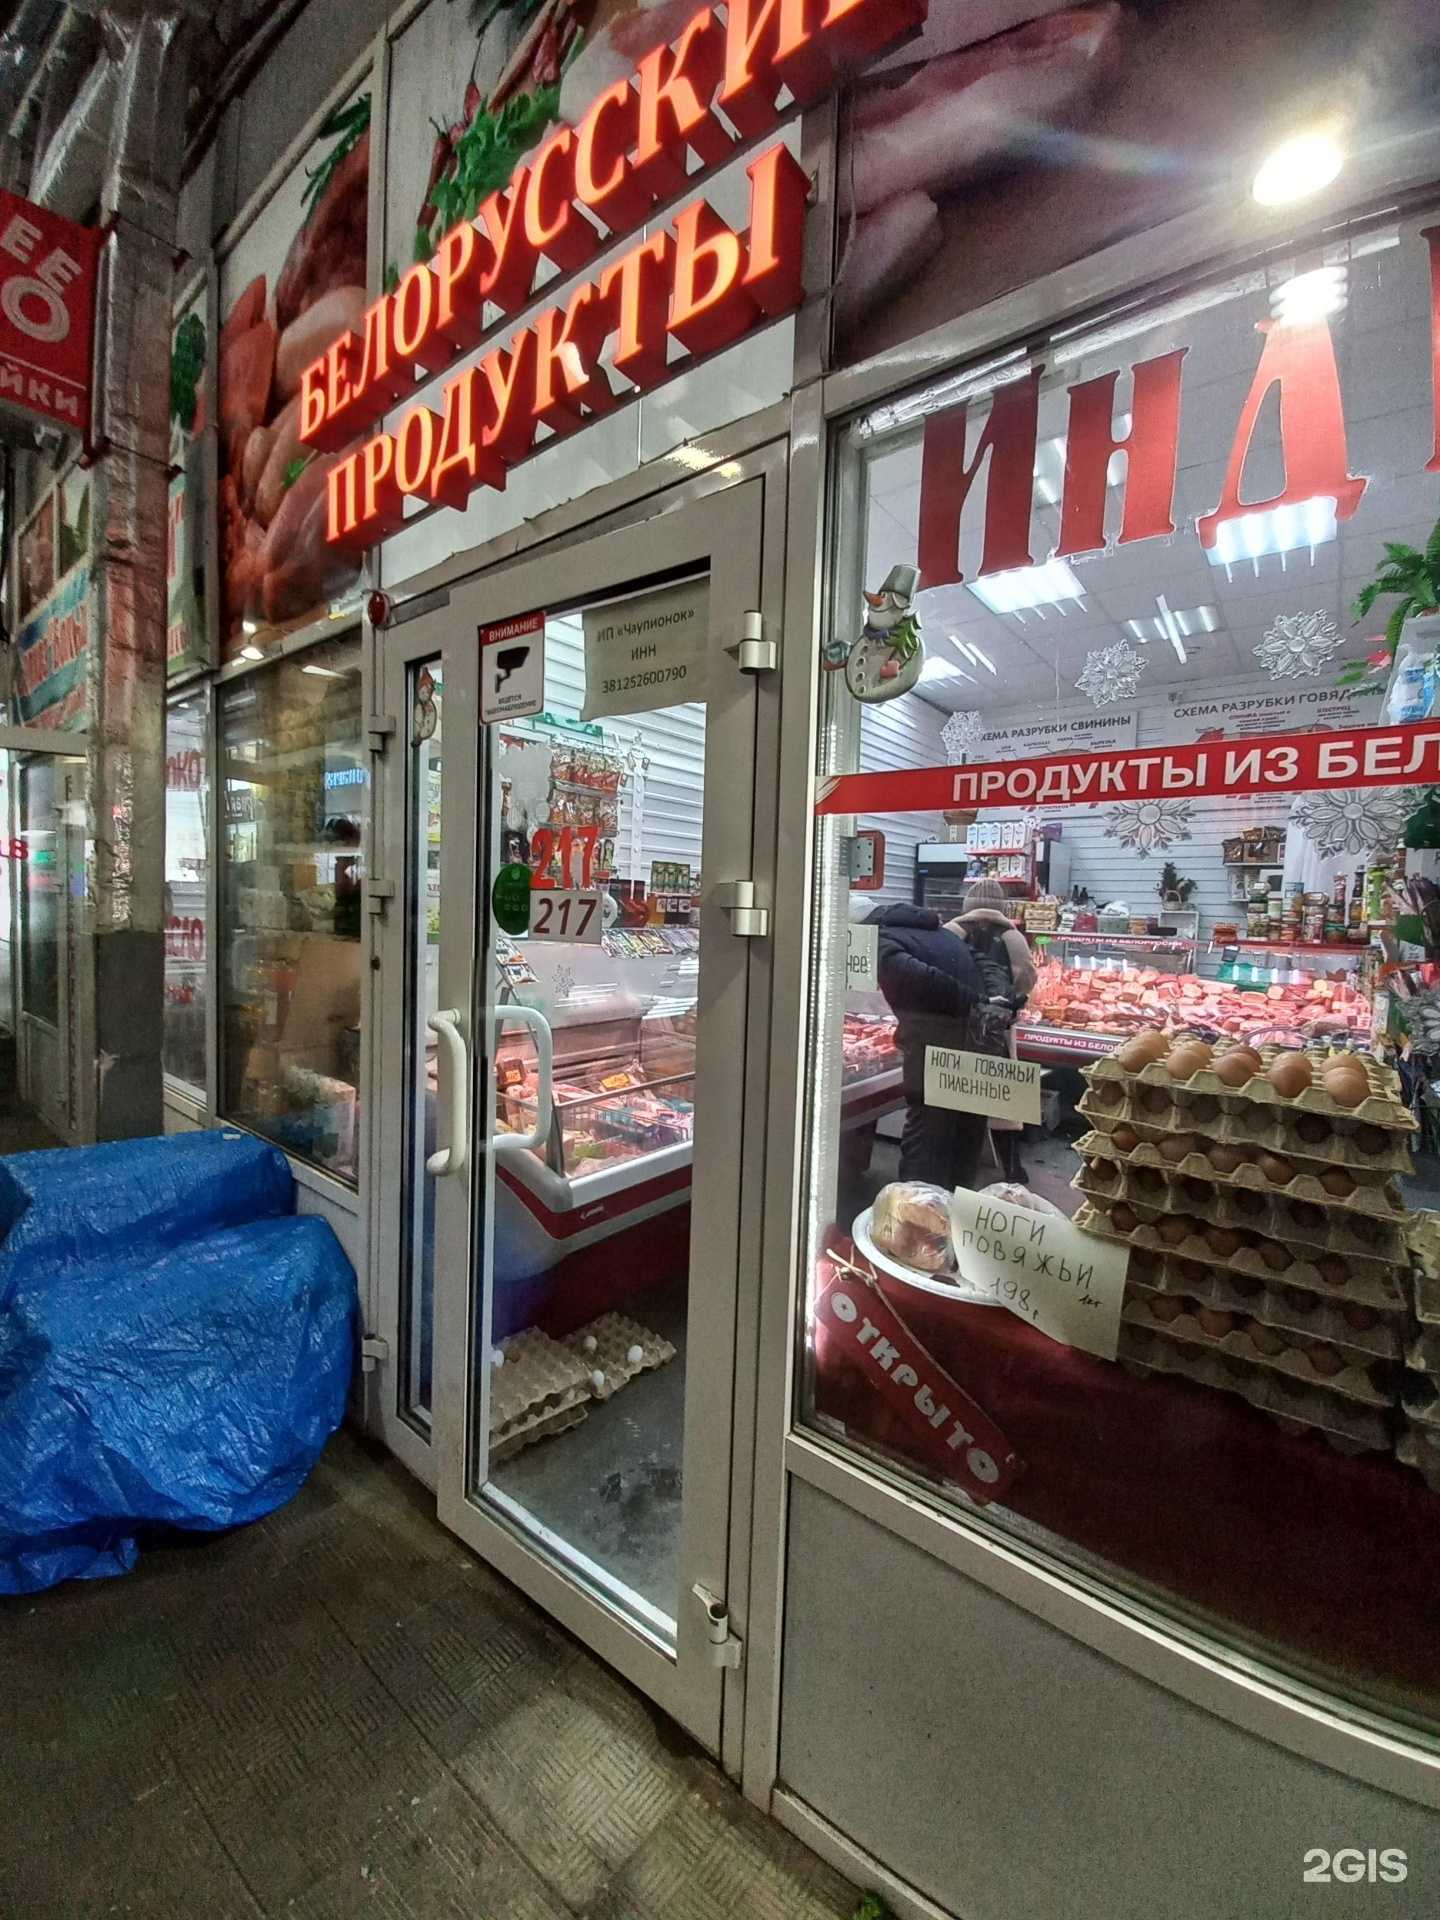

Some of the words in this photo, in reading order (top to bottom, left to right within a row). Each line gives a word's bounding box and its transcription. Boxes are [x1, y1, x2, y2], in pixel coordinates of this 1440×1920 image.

[299, 0, 865, 442] БЕЛОРУССКИ
[325, 141, 792, 542] ПРОДУКТЫ
[916, 226, 1440, 592] ИНД
[489, 617, 538, 642] ВНИМАНИЕ
[597, 627, 614, 642] ИП
[631, 644, 657, 661] ИНН
[602, 665, 688, 694] 381252600790
[1174, 705, 1218, 719] СХЕМА
[1222, 695, 1295, 713] РАЗРУБКИ
[981, 731, 1009, 742] ХЕМА
[1011, 723, 1067, 739] РАЗРУБКИ
[1070, 715, 1131, 732] СВИНИНЫ
[952, 753, 1207, 802] ПРОДУКТЫ
[1223, 746, 1299, 785] ИЗ
[530, 825, 602, 890] 217
[532, 897, 598, 937] 217
[1024, 1033, 1073, 1046] ПРОДУКТЫ
[930, 1049, 961, 1071] НОГИ
[975, 1057, 1035, 1085] ГОВЯЖЬИ
[975, 1205, 1046, 1246] НОГИ
[831, 1291, 1000, 1484] ОТКРЫТО
